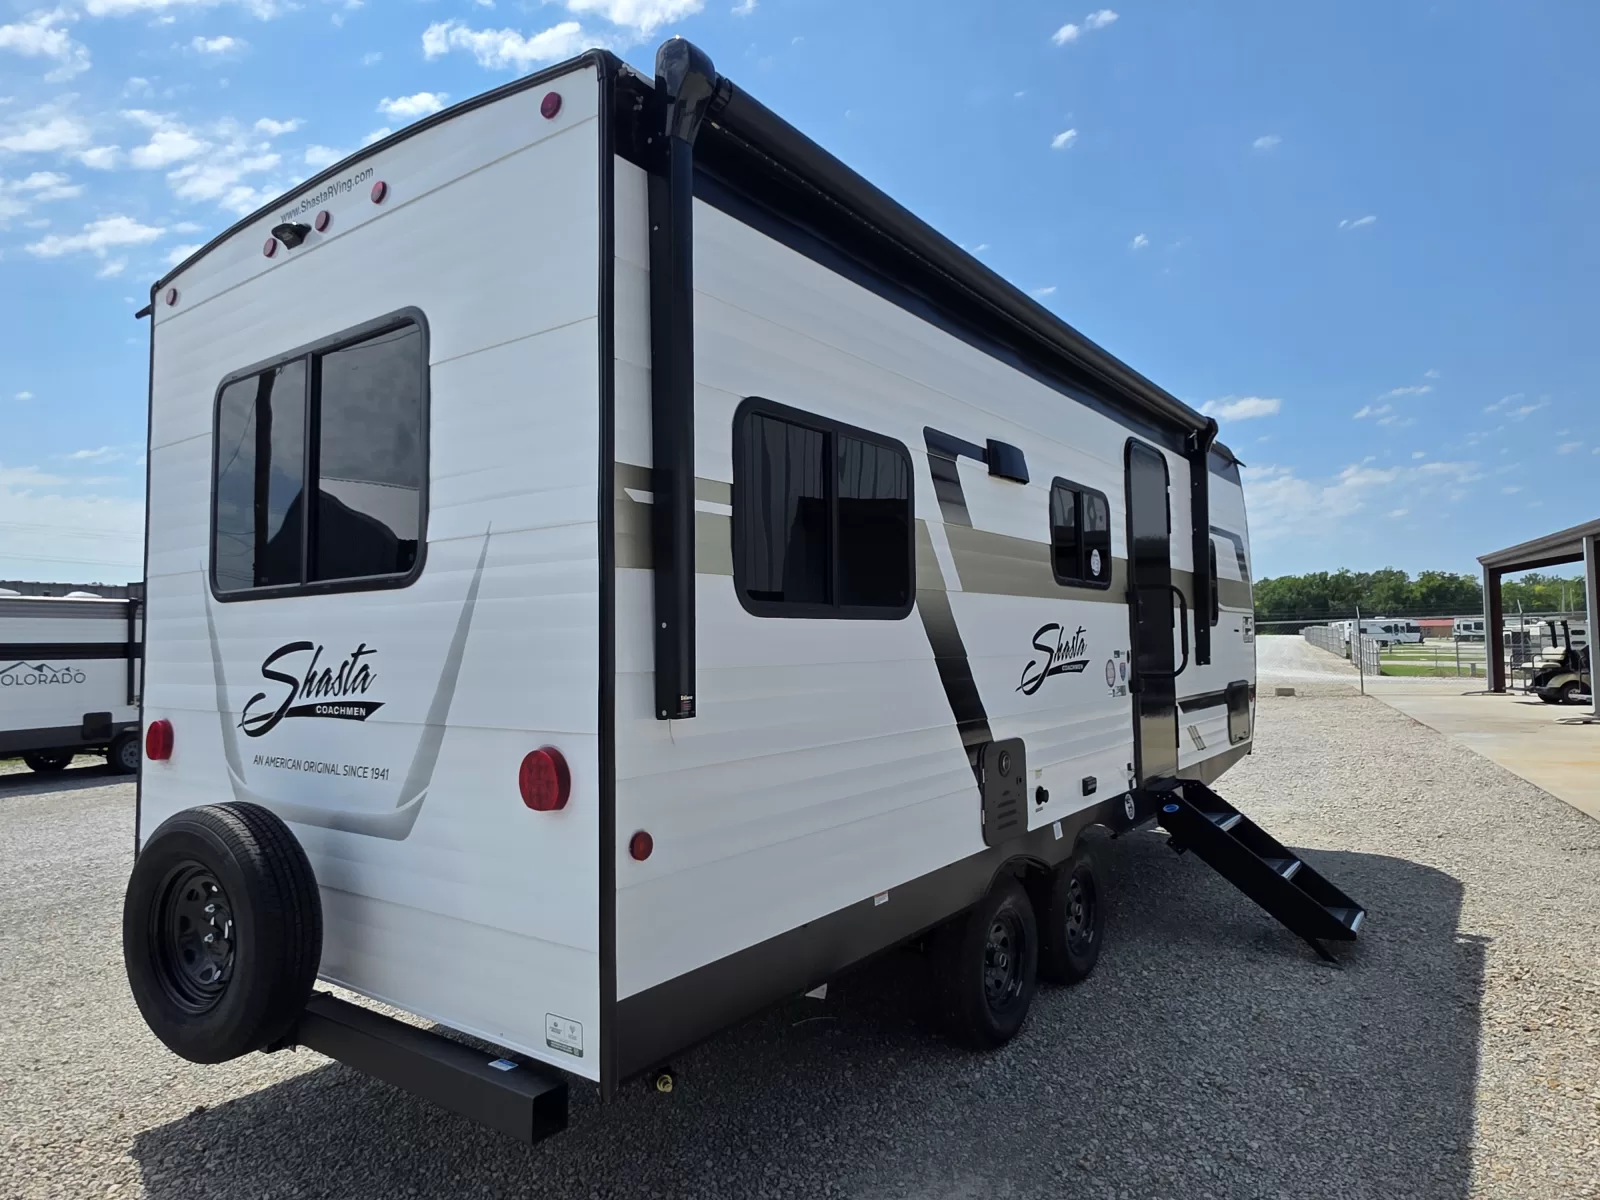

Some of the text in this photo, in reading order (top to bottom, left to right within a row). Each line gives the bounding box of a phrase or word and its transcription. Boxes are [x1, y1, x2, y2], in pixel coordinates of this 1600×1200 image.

[280, 167, 374, 223] www.ShastaRVing.com
[1020, 622, 1088, 696] Shasta
[241, 640, 378, 737] Shasta
[315, 705, 366, 716] COACHMEN
[253, 754, 390, 781] AN AMERICAN ORIGINAL SINCE 1941
